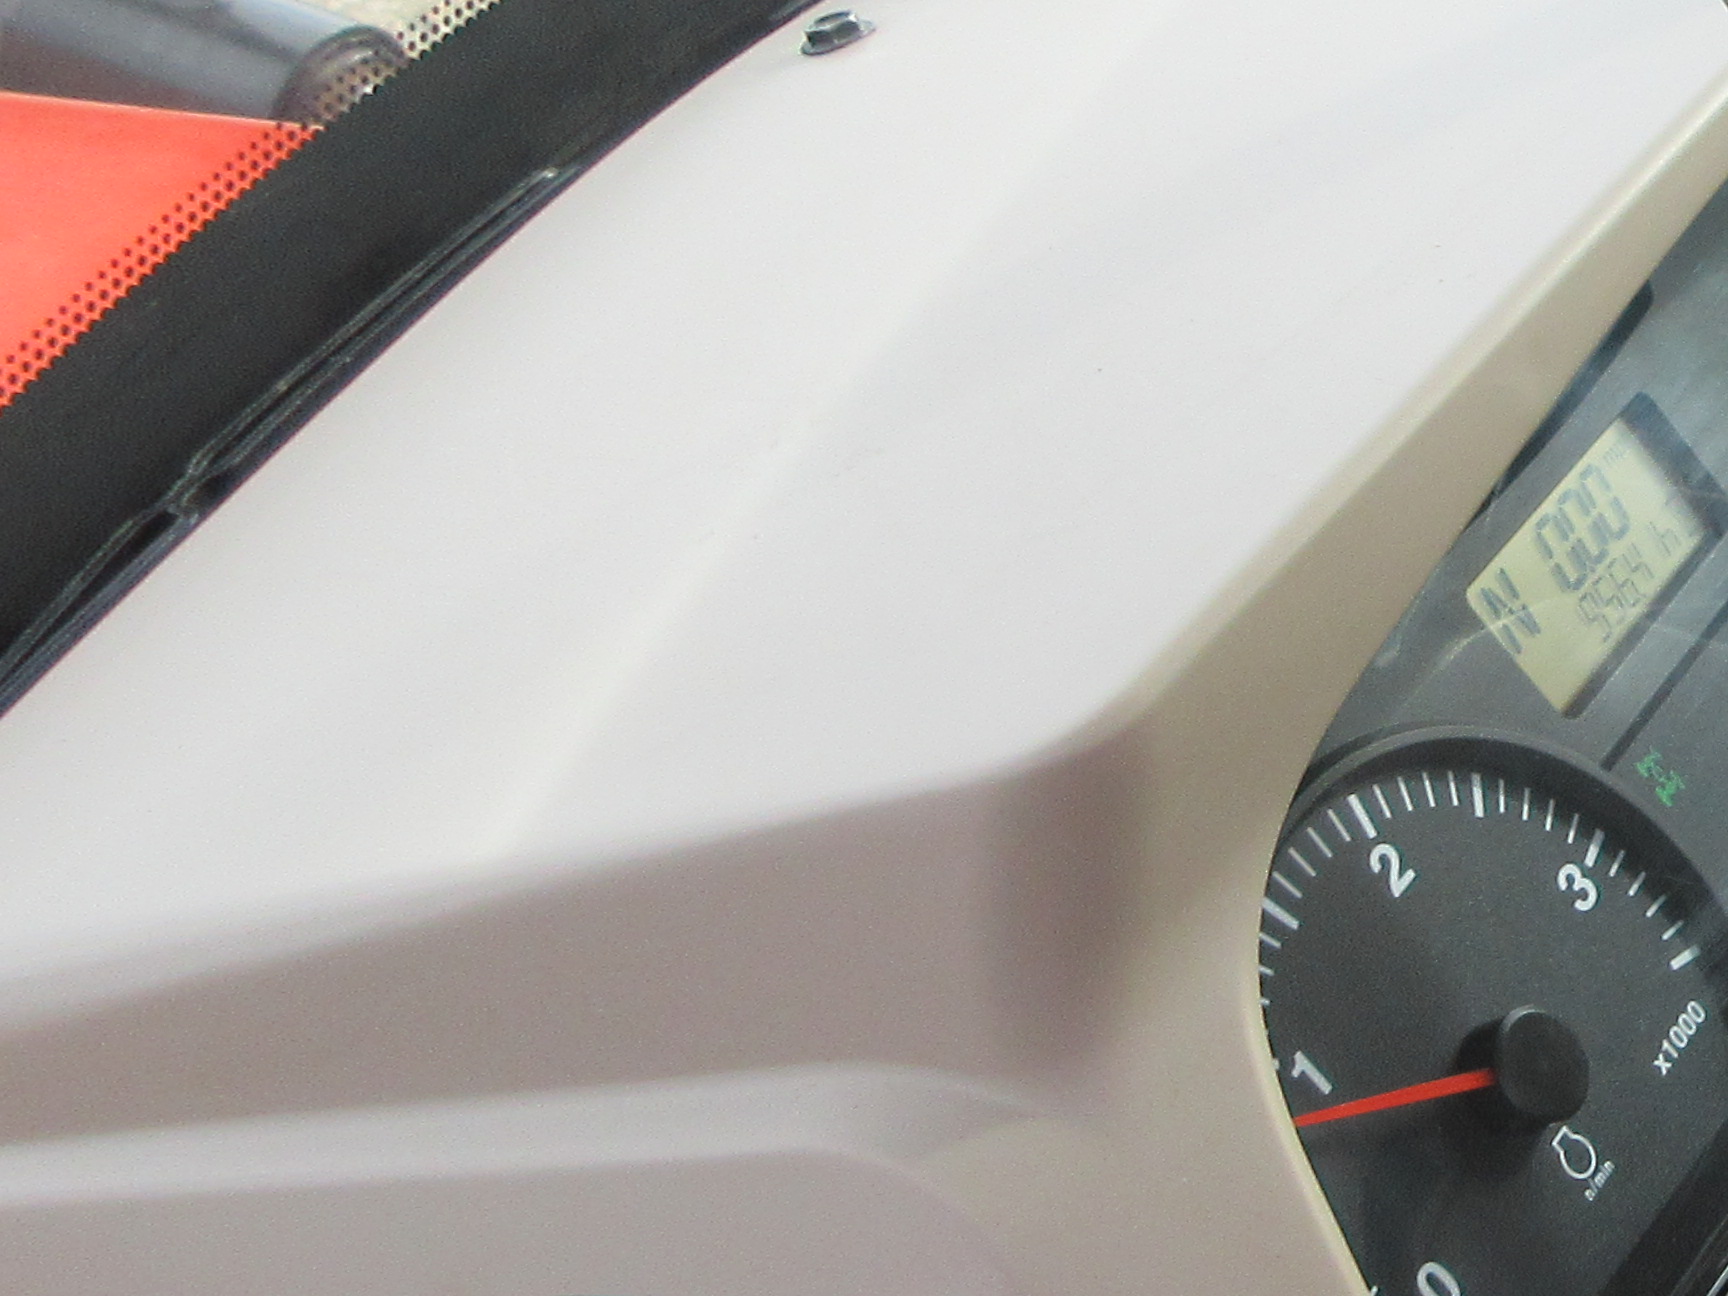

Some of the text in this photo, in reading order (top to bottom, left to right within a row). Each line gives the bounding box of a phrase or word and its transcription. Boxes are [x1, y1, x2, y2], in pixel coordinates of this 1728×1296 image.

[1480, 567, 1541, 654] N
[1370, 843, 1417, 898] 2
[1556, 863, 1600, 912] 3
[1653, 1000, 1706, 1076] x1000
[1290, 1051, 1333, 1095] 1
